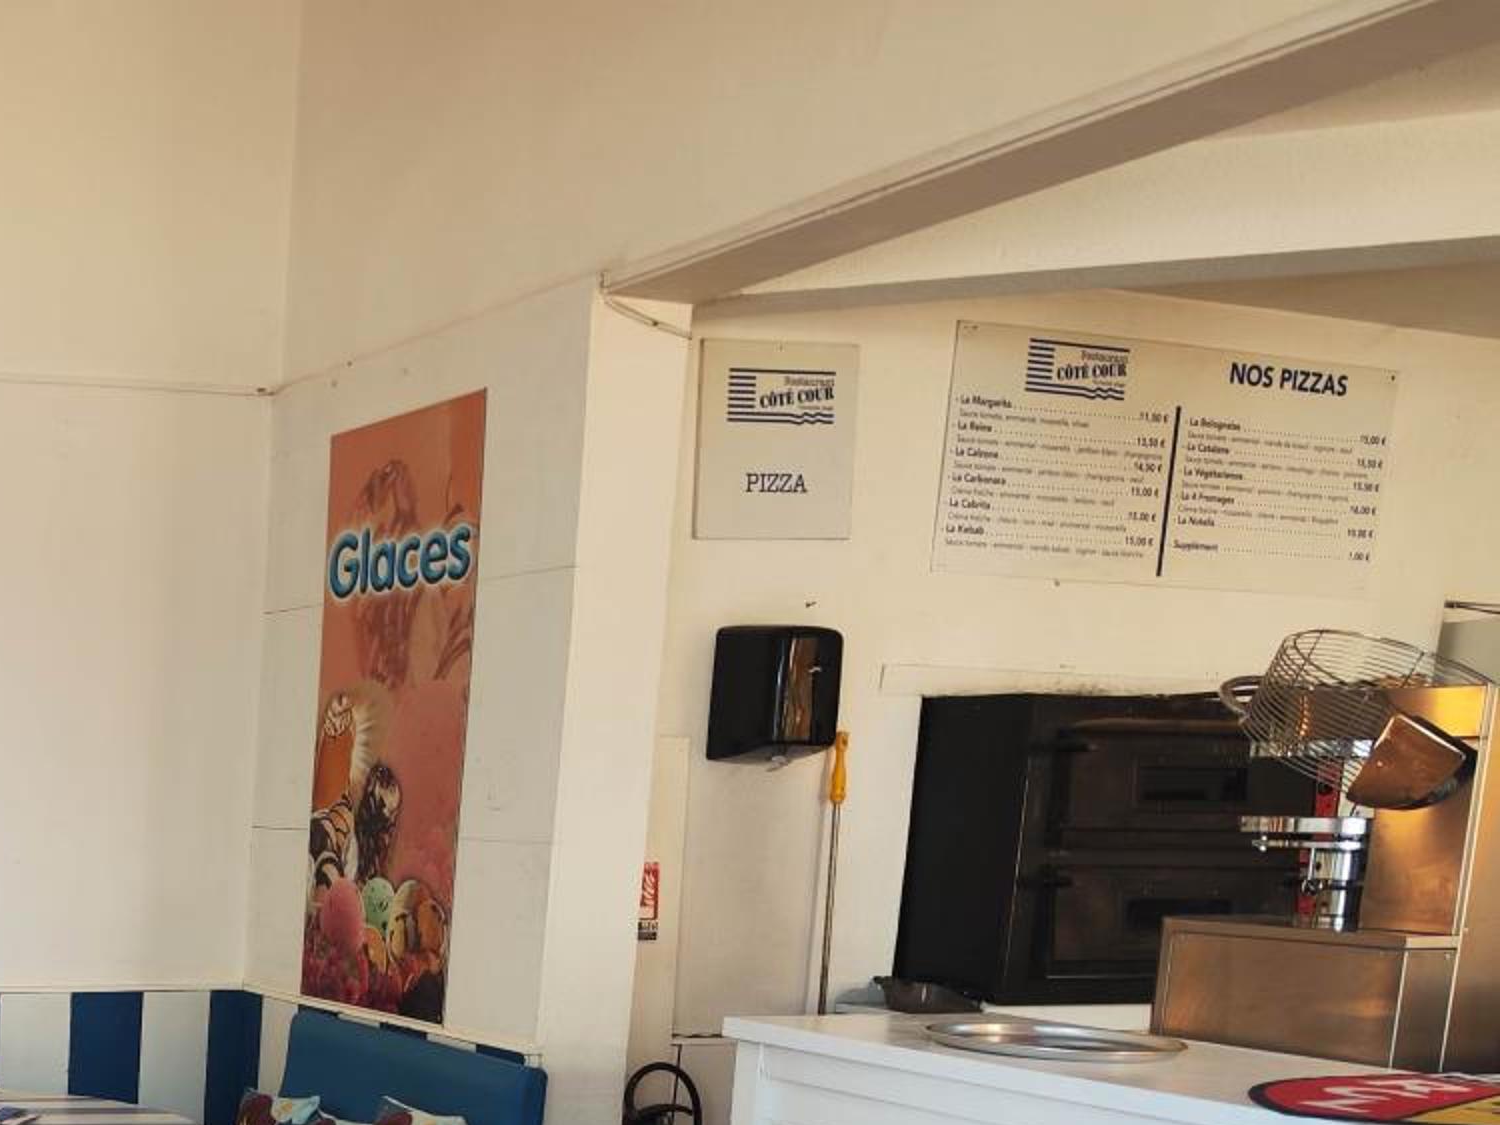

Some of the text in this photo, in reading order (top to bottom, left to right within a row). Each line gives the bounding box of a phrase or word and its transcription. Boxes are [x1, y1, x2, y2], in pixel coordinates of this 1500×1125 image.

[1056, 363, 1127, 381] CÔTÉ COUR
[1229, 362, 1349, 396] NOS PIZZAS
[759, 386, 836, 409] CÔTÉ COUR
[961, 396, 970, 405] La
[958, 421, 993, 432] La Reine
[1190, 417, 1199, 427] La
[1188, 443, 1197, 453] La
[955, 447, 965, 457] La
[966, 448, 999, 460] Calzone
[1184, 467, 1193, 476] La
[746, 472, 807, 493] PIZZA
[952, 474, 962, 483] La
[1181, 492, 1191, 501] La
[949, 499, 960, 508] La
[1178, 516, 1187, 525] La
[946, 525, 956, 533] La
[329, 526, 471, 599] Glaces
